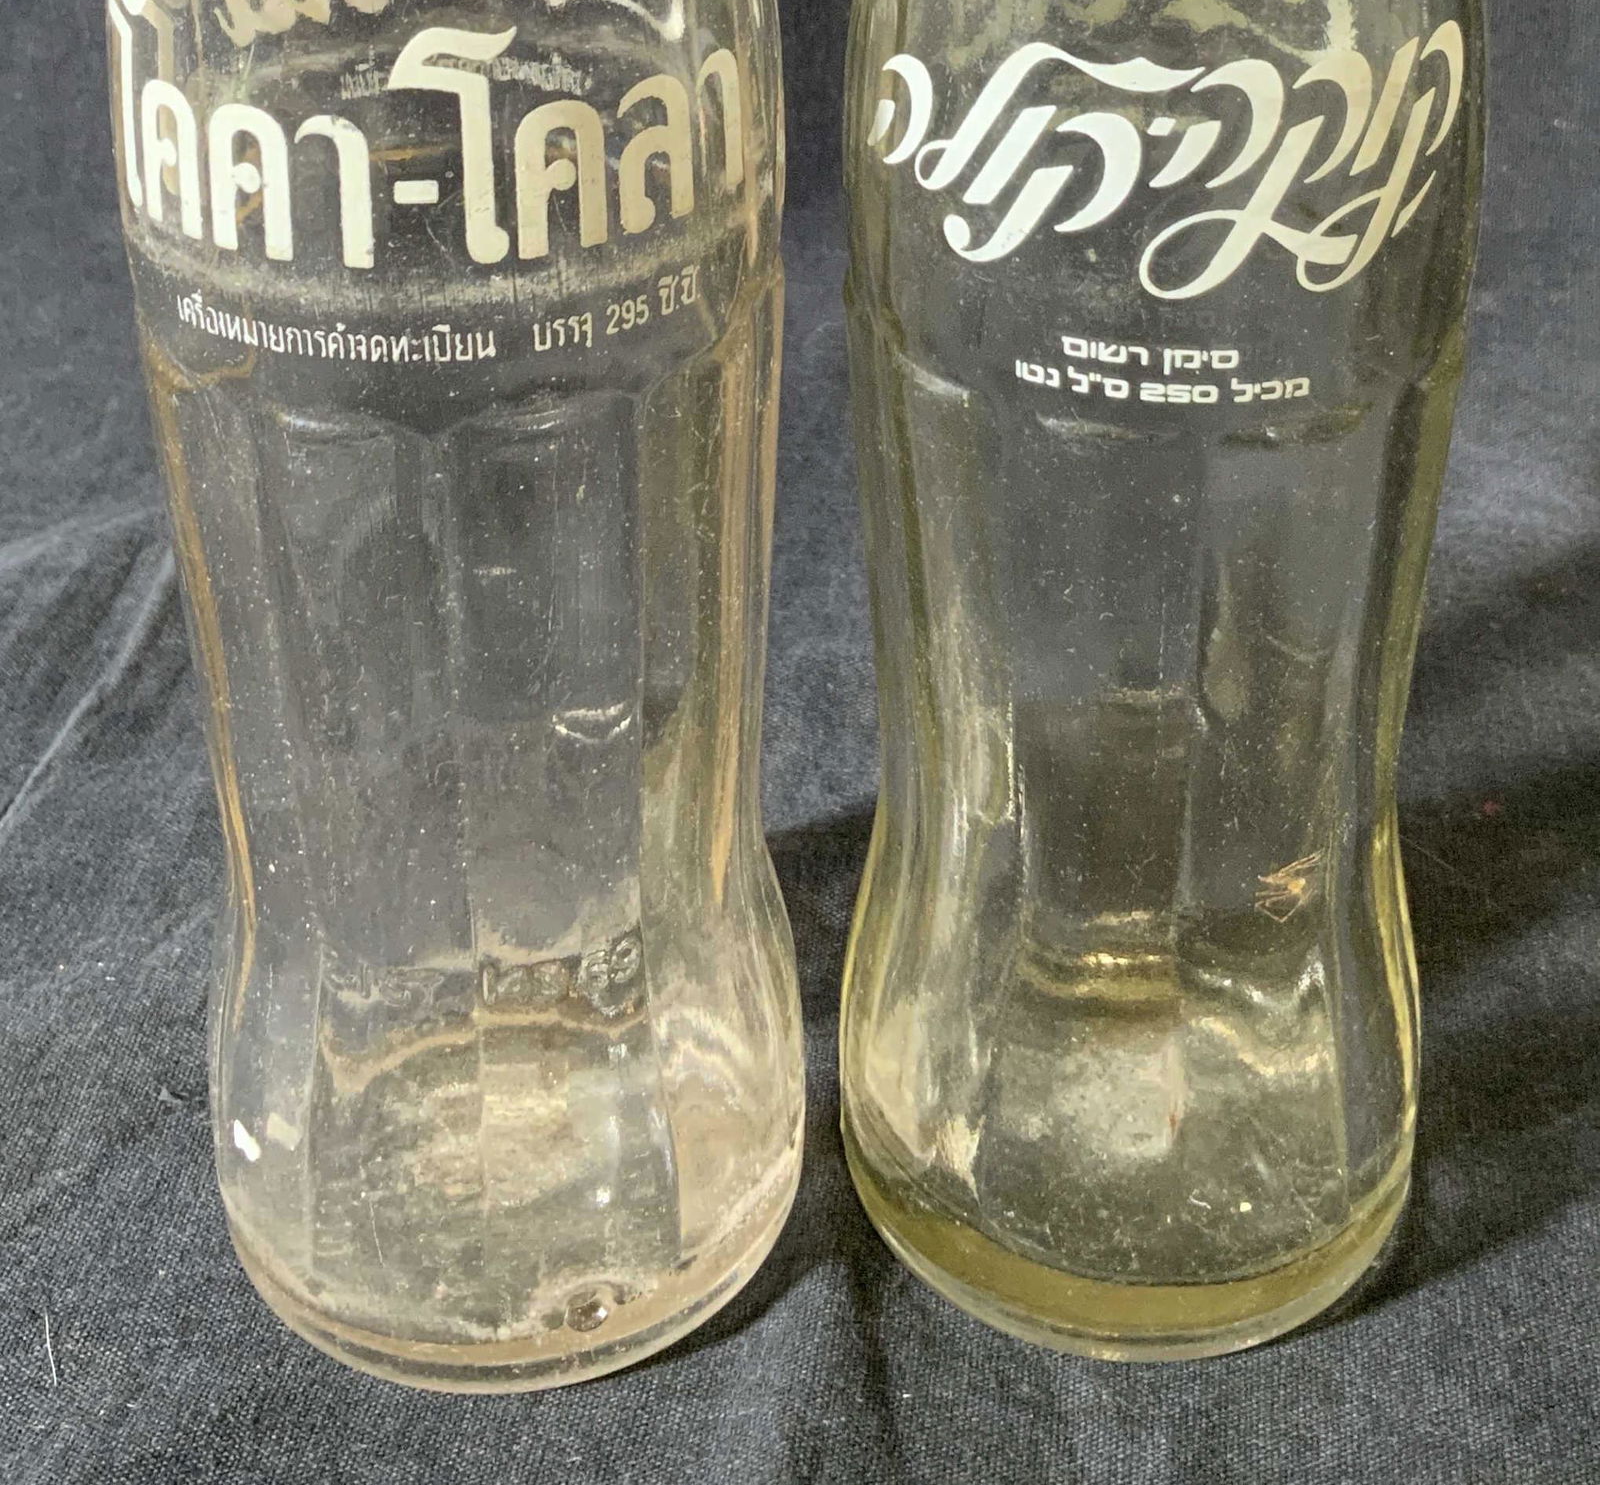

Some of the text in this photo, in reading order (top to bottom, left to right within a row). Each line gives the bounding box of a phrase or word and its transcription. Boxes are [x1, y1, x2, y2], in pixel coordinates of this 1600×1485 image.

[606, 294, 650, 335] 295
[1061, 335, 1240, 376] סימן רשום
[1015, 359, 1061, 389] נטו
[1139, 382, 1219, 404] 250
[1230, 377, 1310, 404] מכיל
